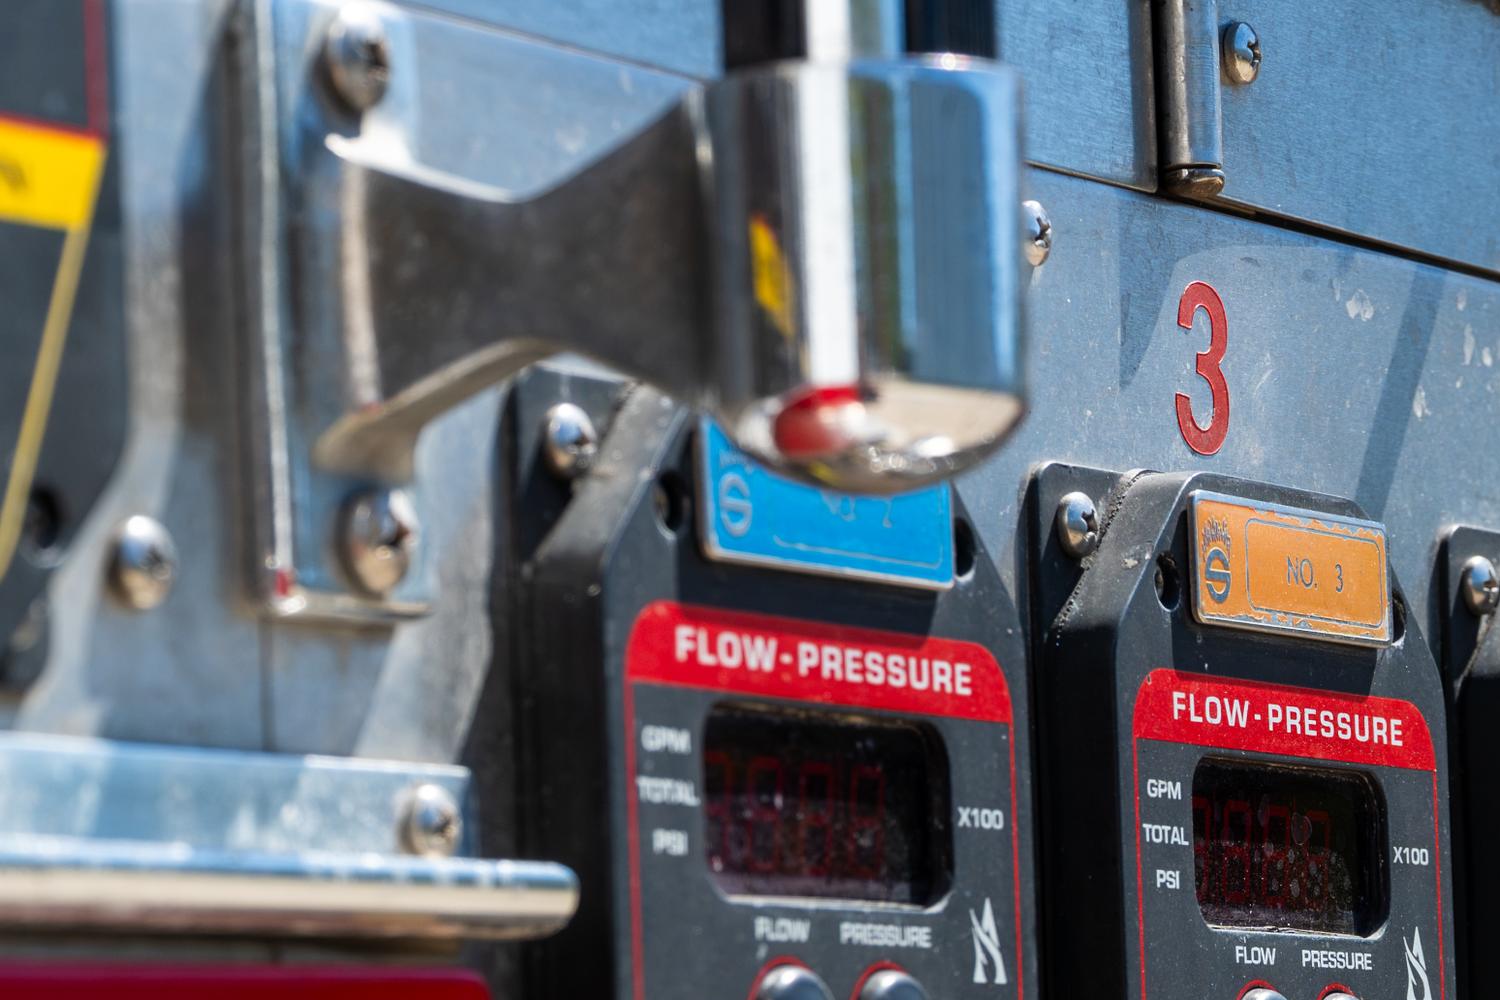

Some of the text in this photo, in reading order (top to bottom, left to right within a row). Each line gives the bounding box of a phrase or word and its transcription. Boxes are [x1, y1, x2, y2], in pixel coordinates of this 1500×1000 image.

[1175, 280, 1230, 455] 3
[1287, 557, 1344, 593] NO. 3
[642, 727, 690, 754] GPM
[636, 776, 699, 806] TOTAL
[1147, 779, 1181, 800] GPM
[957, 807, 1004, 830] X100
[654, 830, 688, 856] PSI
[1143, 824, 1189, 846] TOTAL
[1393, 846, 1429, 865] X100
[1156, 870, 1180, 890] PSI
[754, 917, 931, 948] FLOW PRESSURE
[1235, 946, 1372, 970] FLOW PRESSURE
